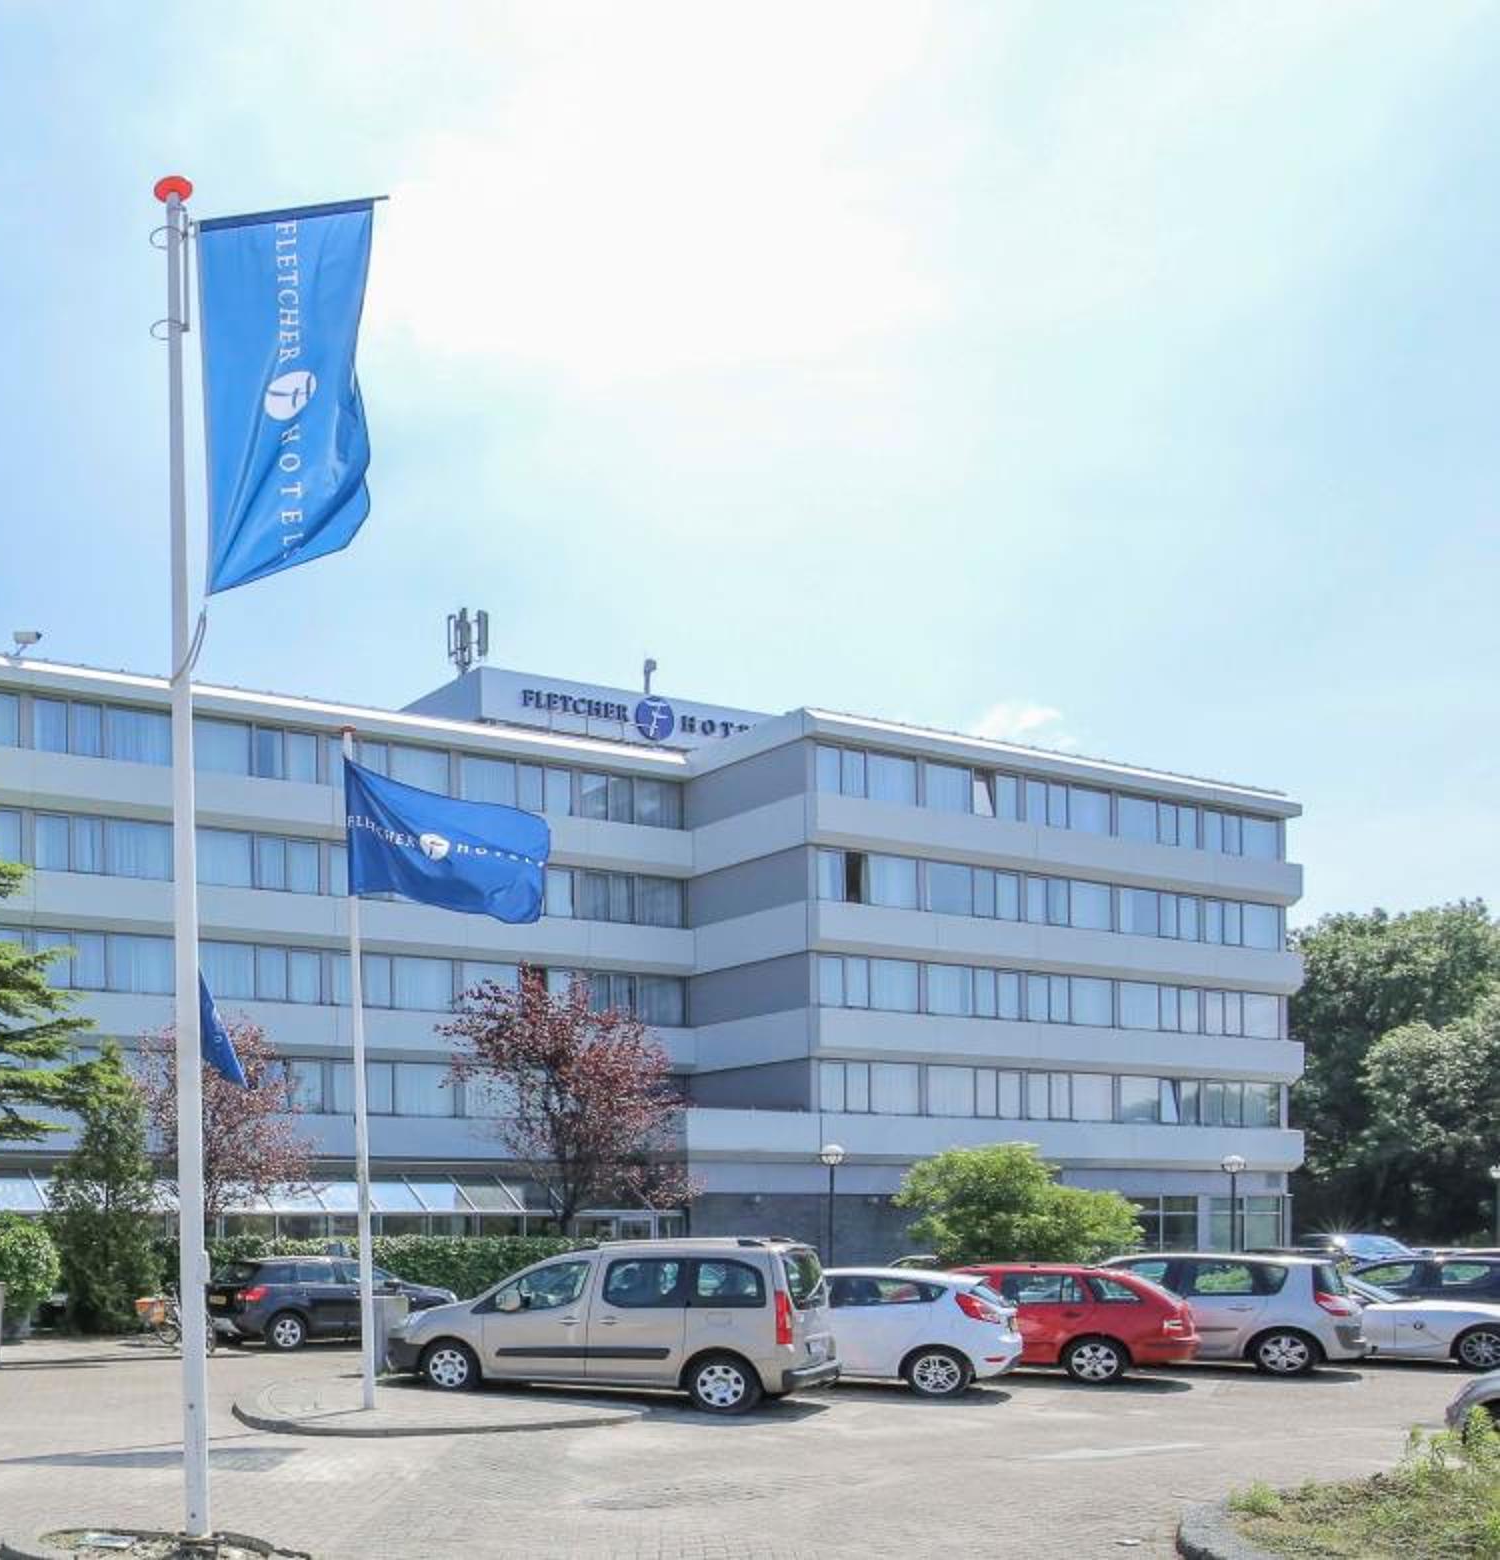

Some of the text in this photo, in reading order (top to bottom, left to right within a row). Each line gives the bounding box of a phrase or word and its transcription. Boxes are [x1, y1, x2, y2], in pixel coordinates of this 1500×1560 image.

[276, 221, 301, 363] FLETCHER
[279, 424, 304, 560] HOTEL
[521, 689, 629, 722] FLETCHER
[681, 715, 757, 738] HOT
